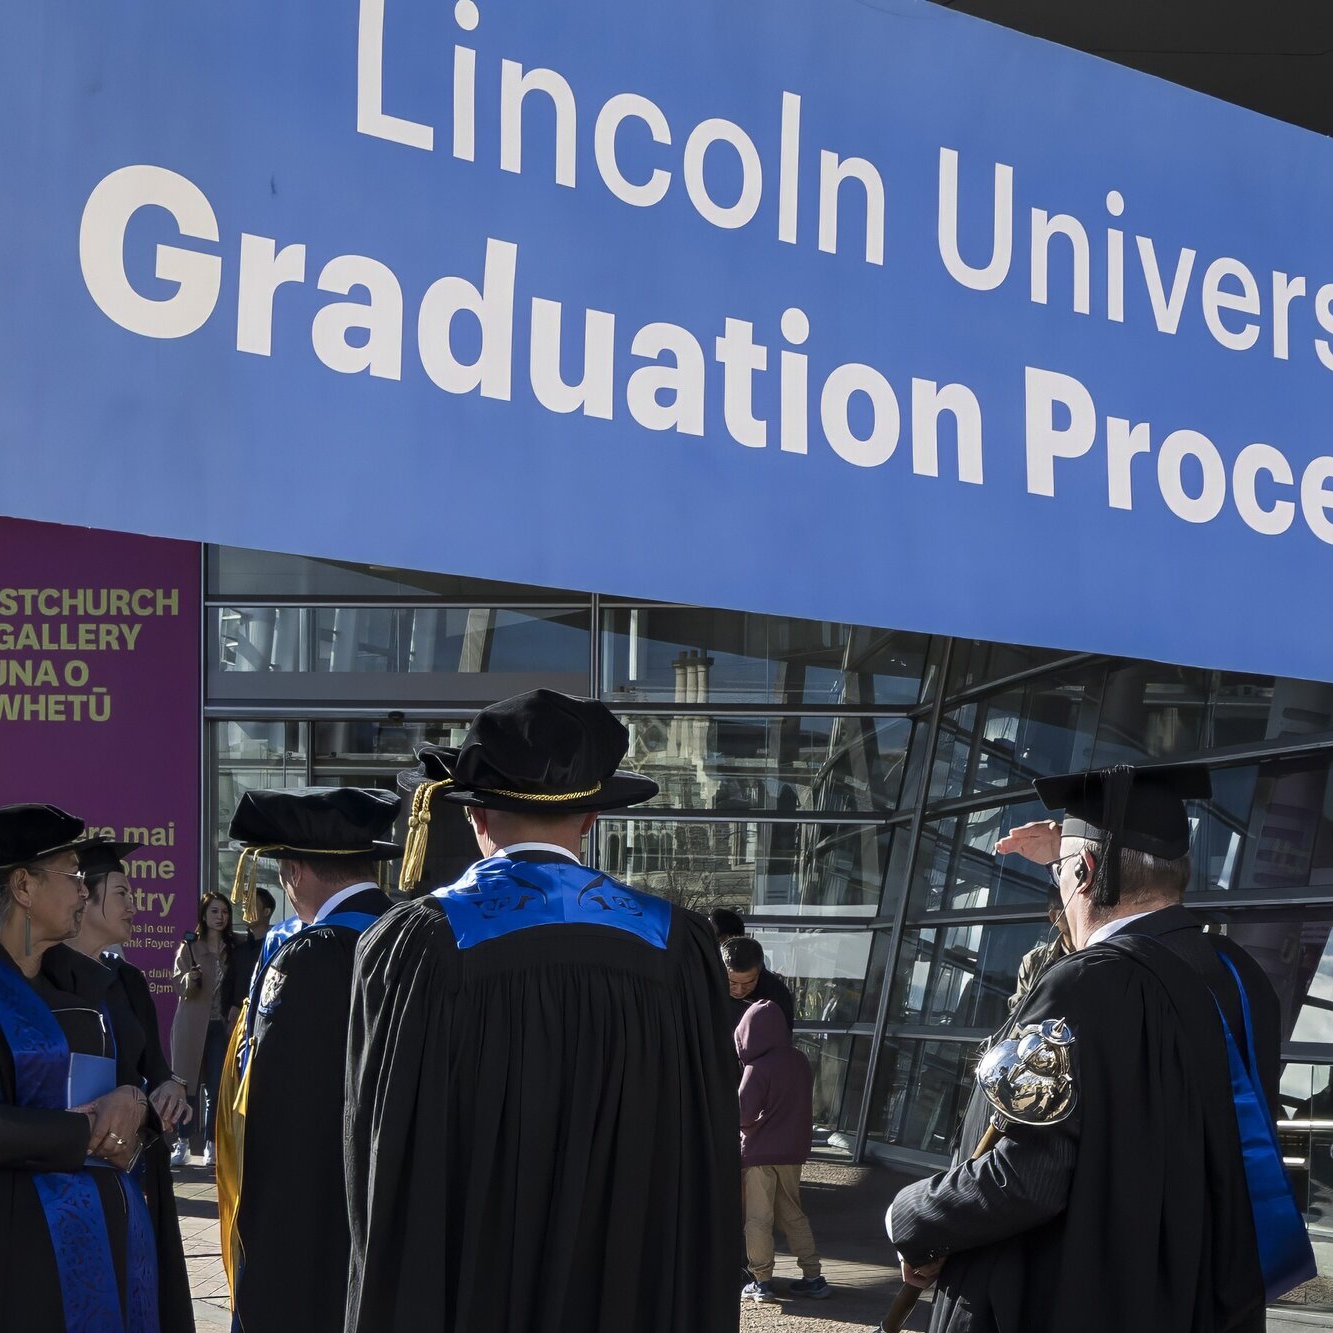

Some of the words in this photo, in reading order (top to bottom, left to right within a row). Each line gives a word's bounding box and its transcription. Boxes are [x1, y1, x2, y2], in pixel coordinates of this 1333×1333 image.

[356, 0, 885, 266] Lincoln
[79, 165, 984, 485] Graduation
[64, 660, 89, 687] O
[123, 822, 175, 846] mai
[134, 888, 175, 917] try
